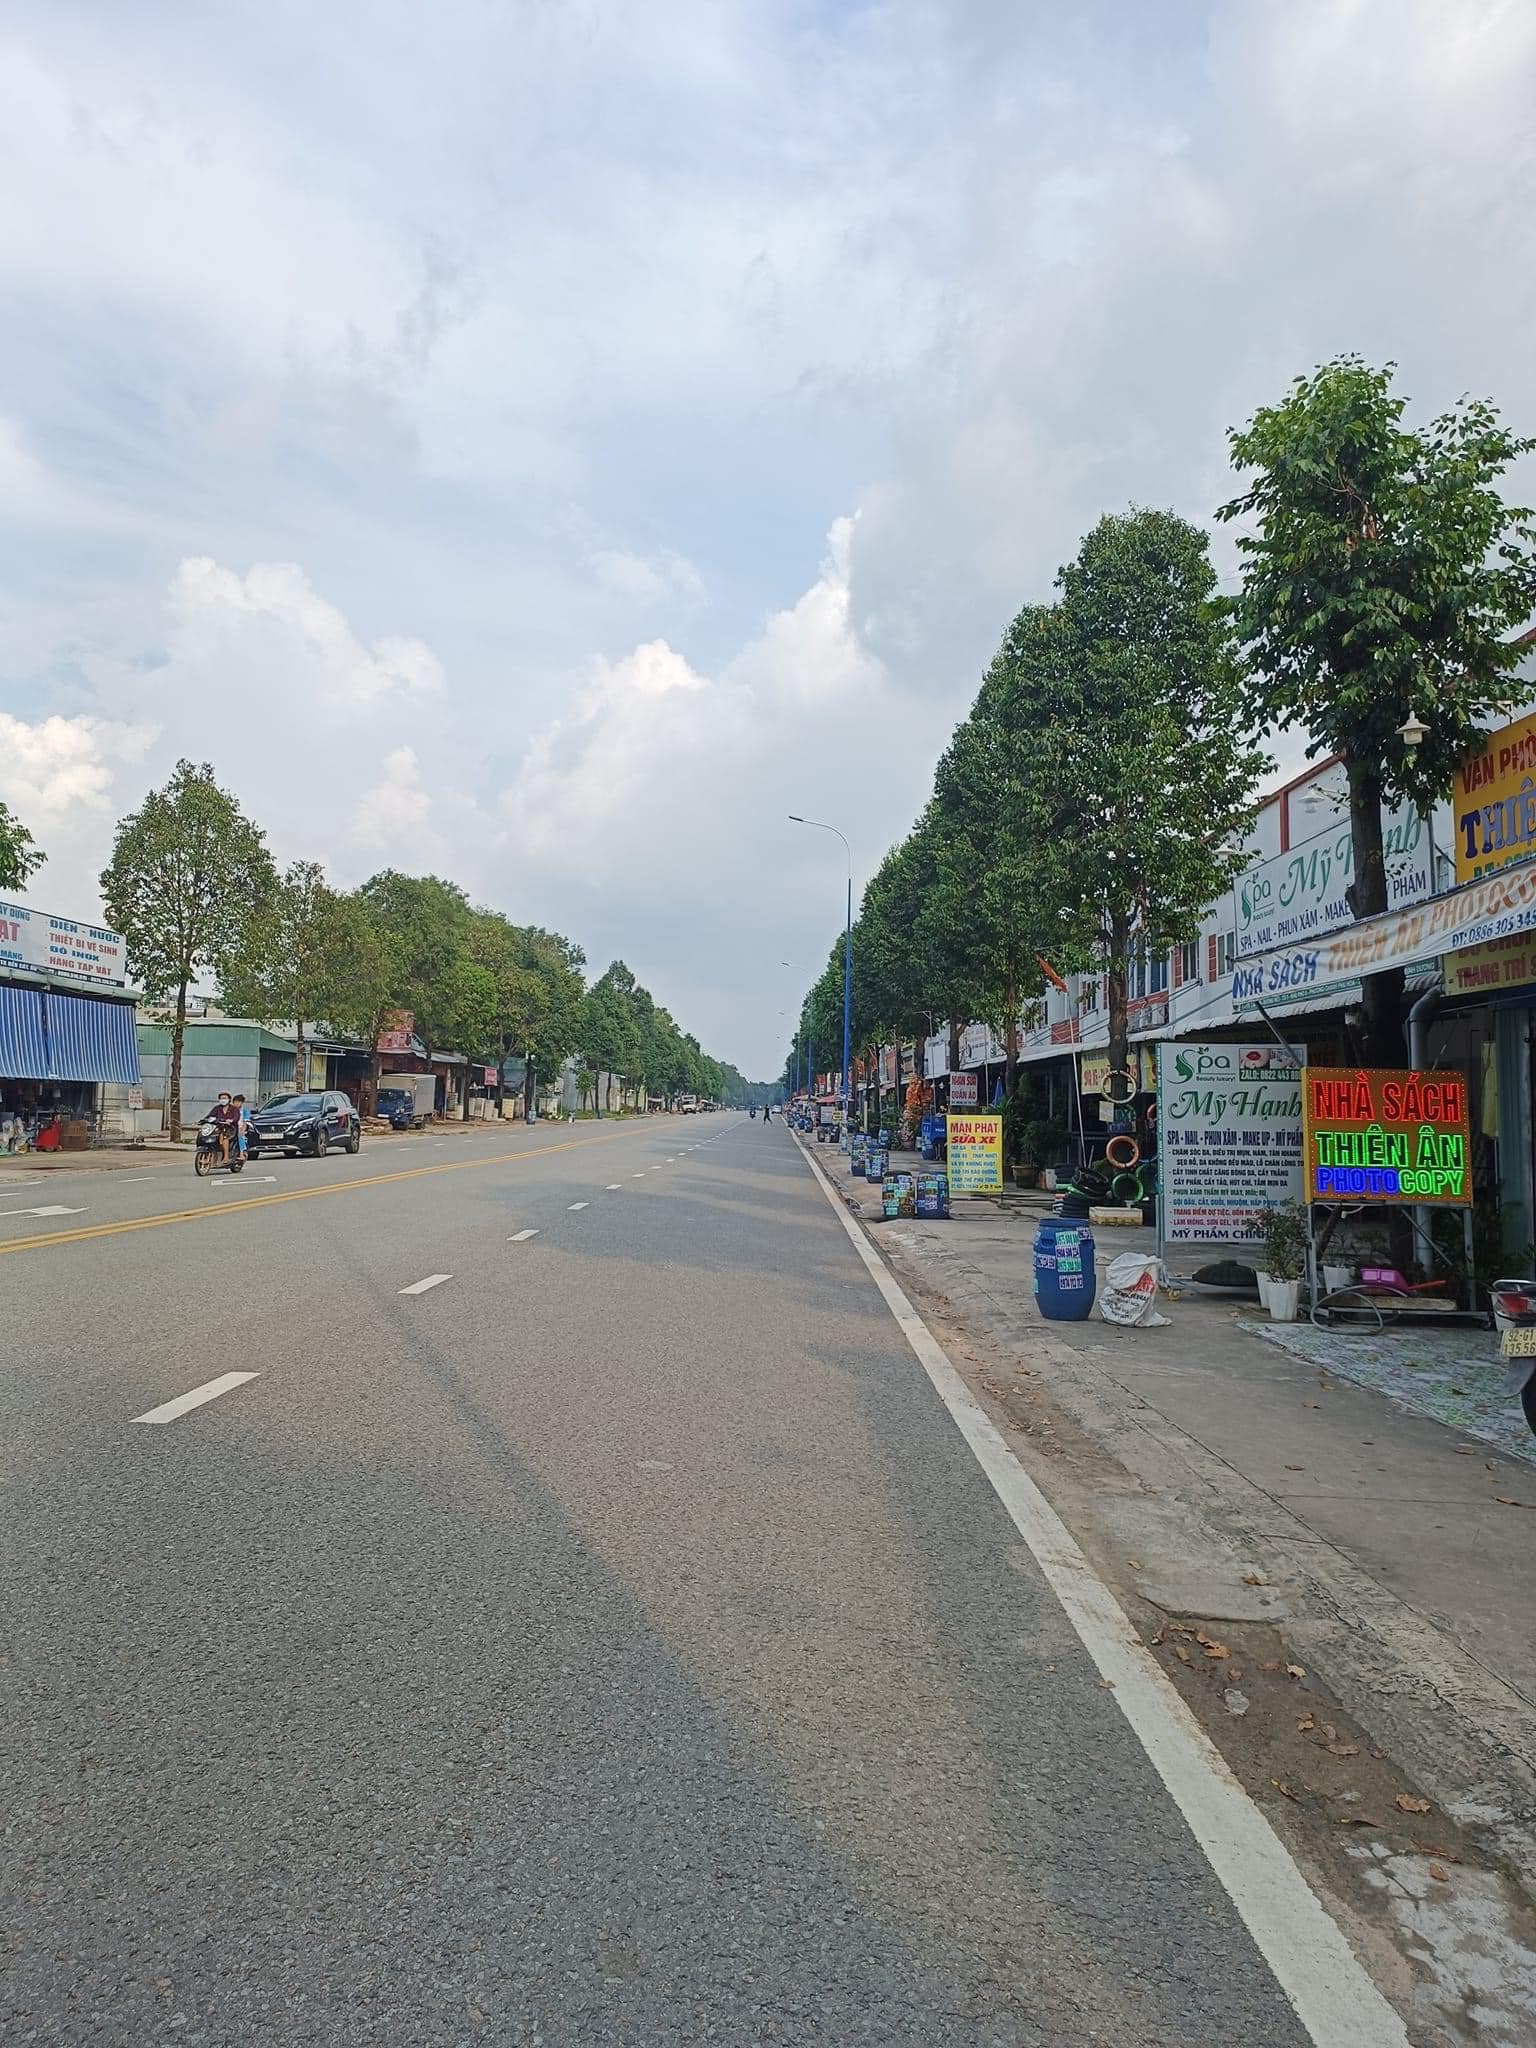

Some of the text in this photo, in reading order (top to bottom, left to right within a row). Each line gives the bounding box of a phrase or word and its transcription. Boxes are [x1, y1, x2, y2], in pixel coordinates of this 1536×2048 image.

[1463, 754, 1494, 794] VĂN
[1240, 935, 1253, 952] SPA
[1257, 926, 1272, 943] NAIL
[1278, 916, 1298, 938] PHUN
[1300, 909, 1318, 933] XĂM
[1494, 916, 1514, 936] 305
[71, 950, 99, 962] INOX
[99, 944, 118, 956] SINH
[1232, 957, 1265, 1000] NHÀ
[1269, 948, 1320, 991] SÁCH
[1241, 1069, 1259, 1080] ZALO:
[1168, 1090, 1226, 1125] Mỹ
[1312, 1072, 1462, 1122] NHÀ SÁCH
[979, 1136, 996, 1144] XE
[1167, 1130, 1180, 1145] SPA
[1185, 1130, 1199, 1145] NAIL
[1204, 1130, 1222, 1145] PHUN
[1223, 1128, 1237, 1146] XĂM
[1243, 1131, 1261, 1146] MAKE
[1262, 1131, 1271, 1146] UP
[1415, 1125, 1465, 1169] ÂN
[1317, 1167, 1465, 1196] PHOTOCOPY
[1172, 1229, 1191, 1239] MỸ
[1194, 1226, 1229, 1239] PHẨM
